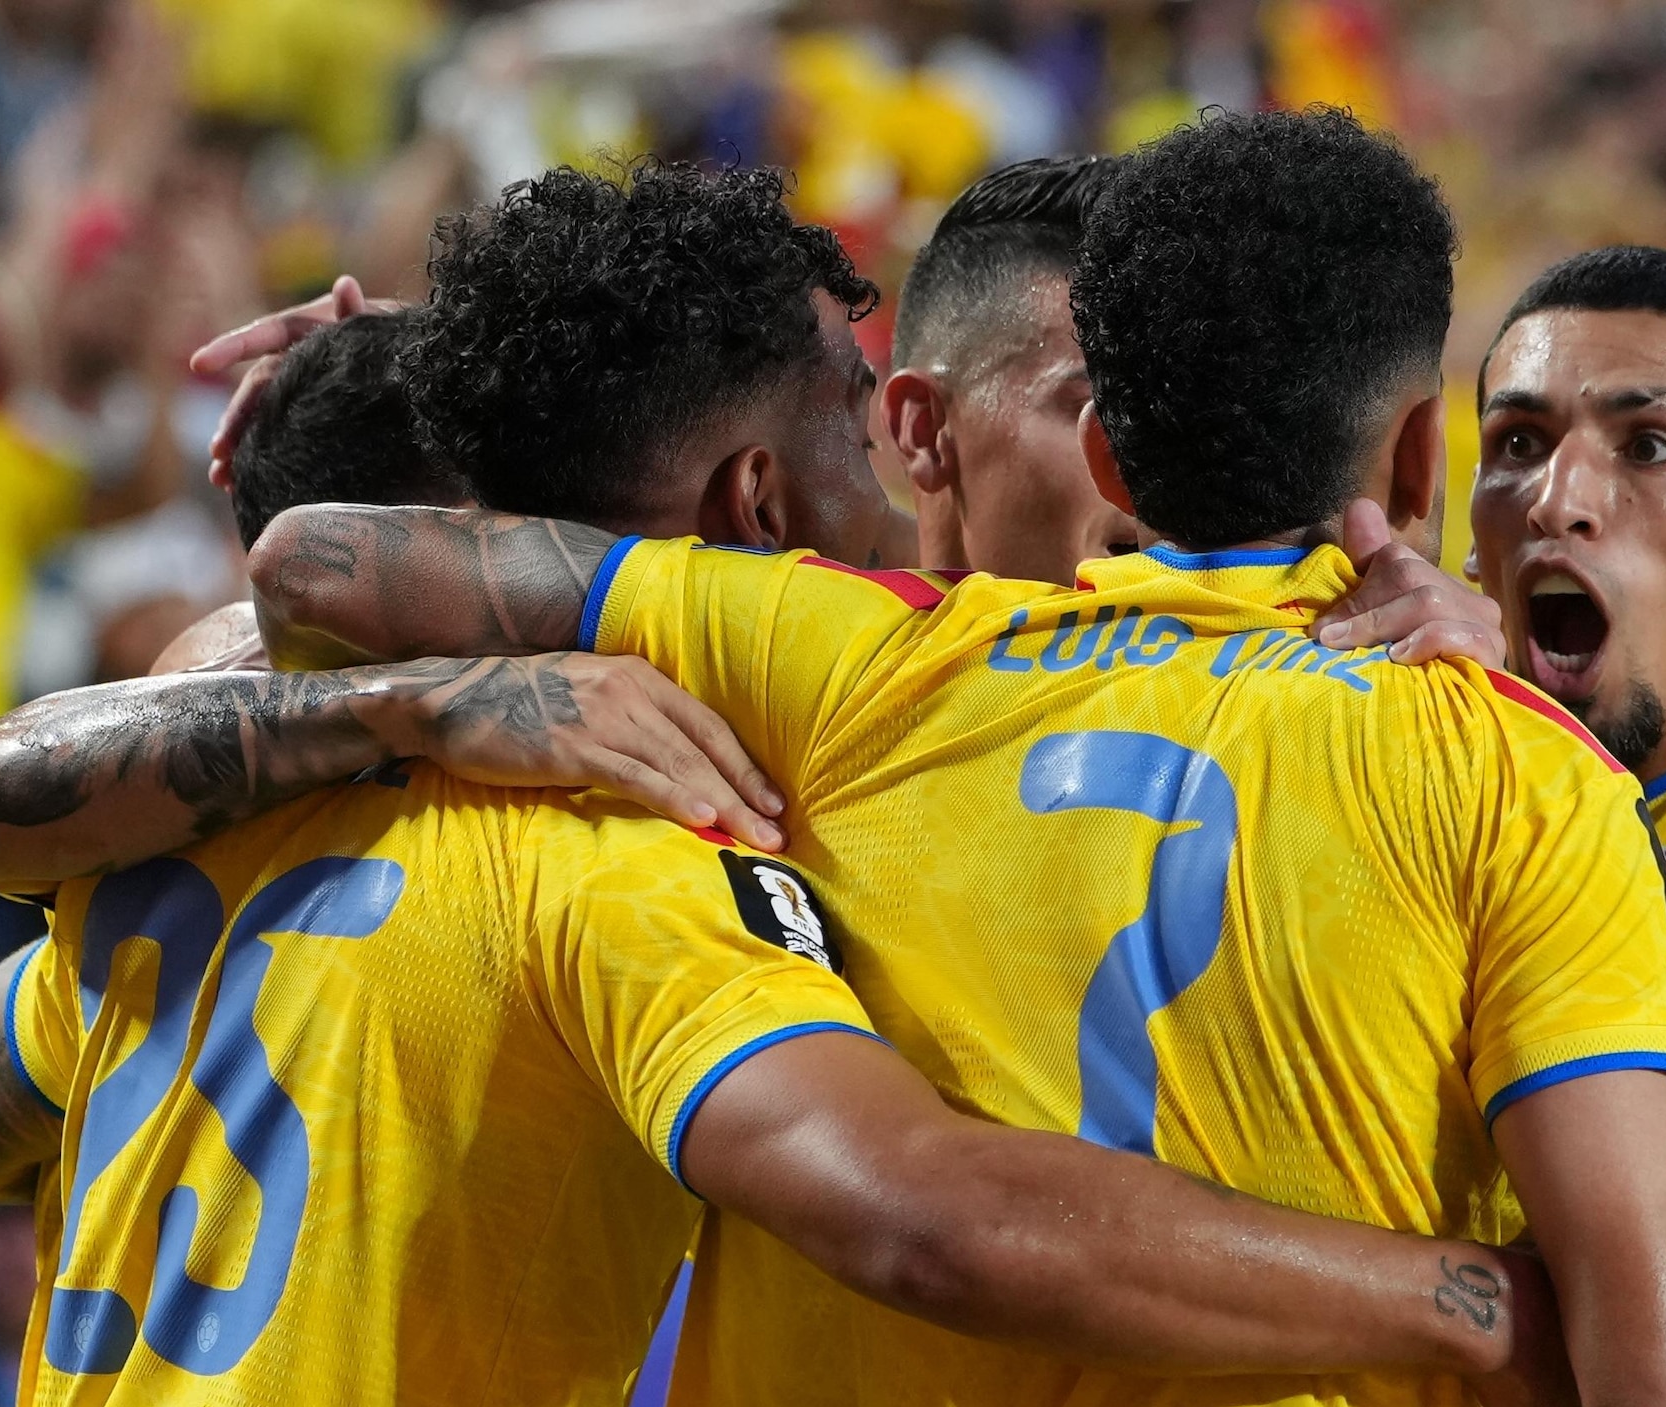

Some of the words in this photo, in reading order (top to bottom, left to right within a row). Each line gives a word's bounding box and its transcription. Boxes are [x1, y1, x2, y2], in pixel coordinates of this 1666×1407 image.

[987, 605, 1195, 673] LUIS
[44, 857, 405, 1375] 25
[1019, 730, 1238, 1158] 7
